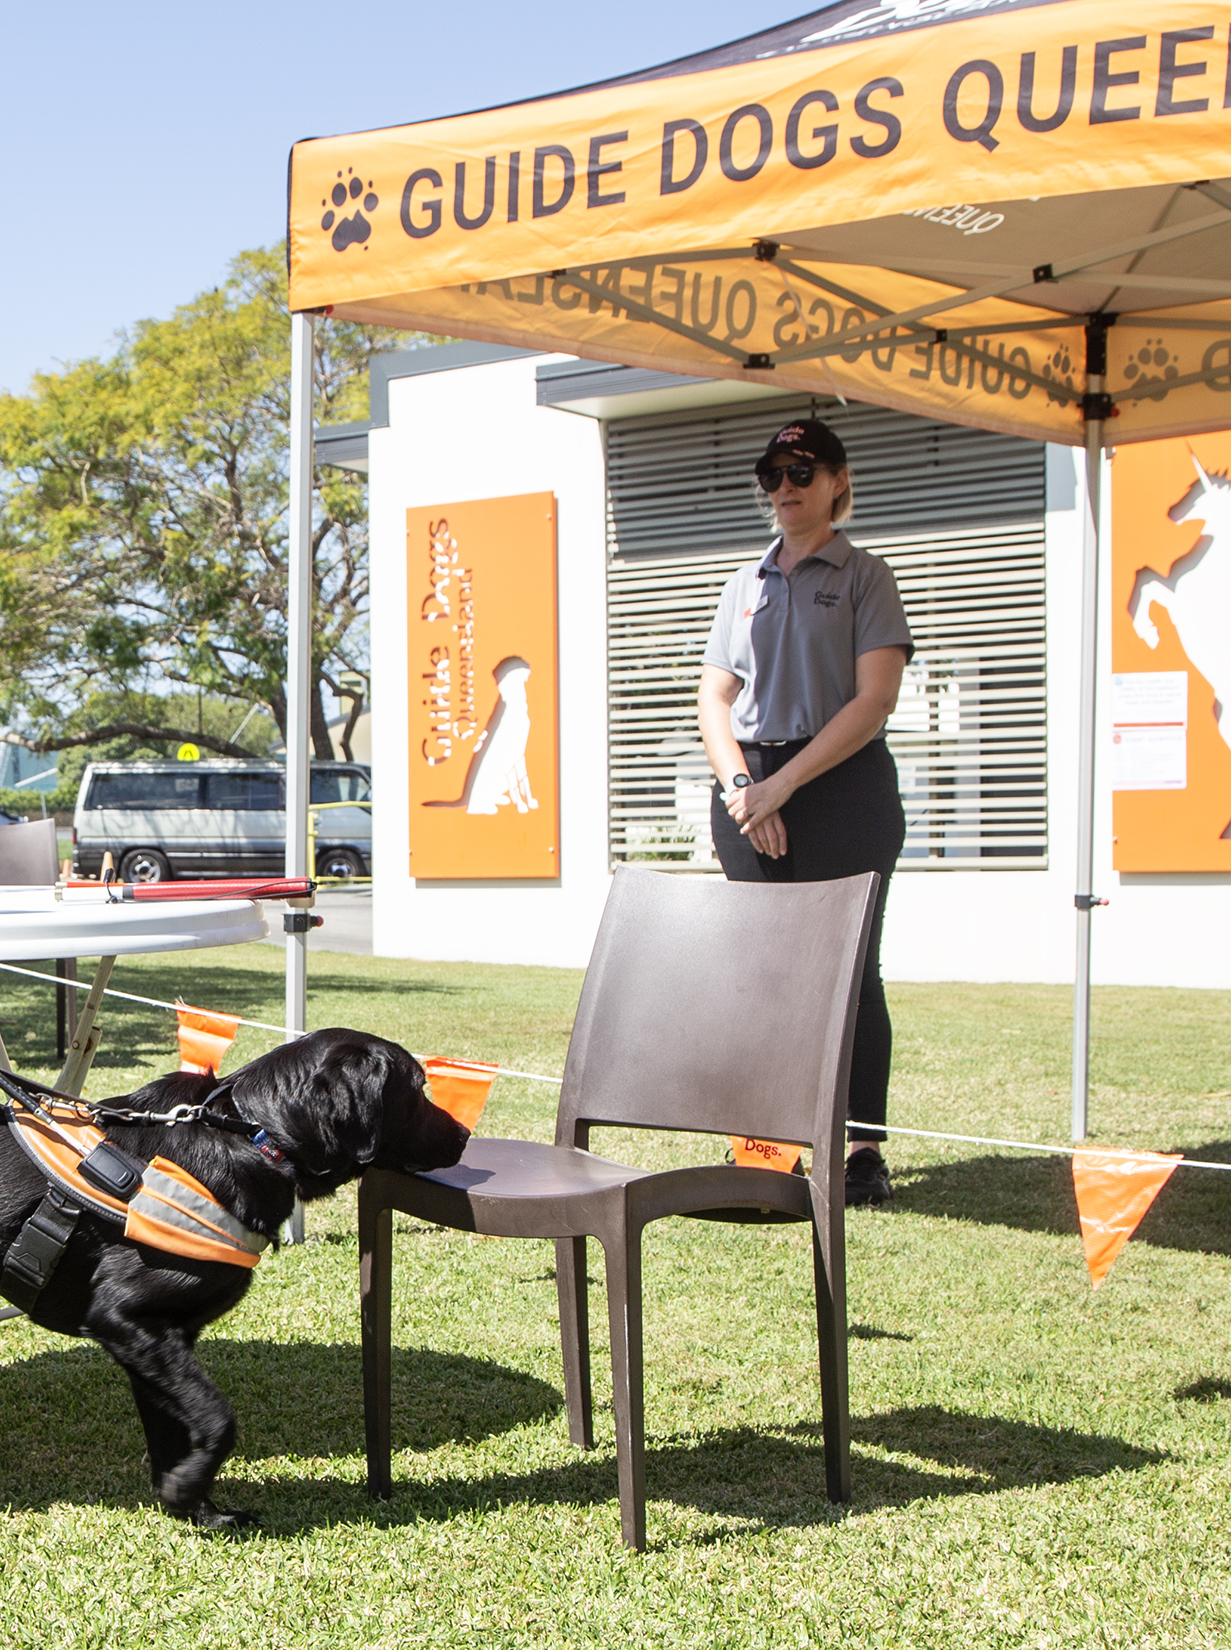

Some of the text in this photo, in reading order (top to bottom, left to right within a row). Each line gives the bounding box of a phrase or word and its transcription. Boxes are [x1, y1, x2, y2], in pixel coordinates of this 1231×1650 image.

[400, 130, 629, 239] GUIDE
[660, 76, 904, 195] DOGS
[943, 22, 1231, 153] QUEE
[422, 517, 457, 766] Guide Dogs
[815, 591, 840, 600] Guide
[745, 1139, 782, 1160] Dogs.
